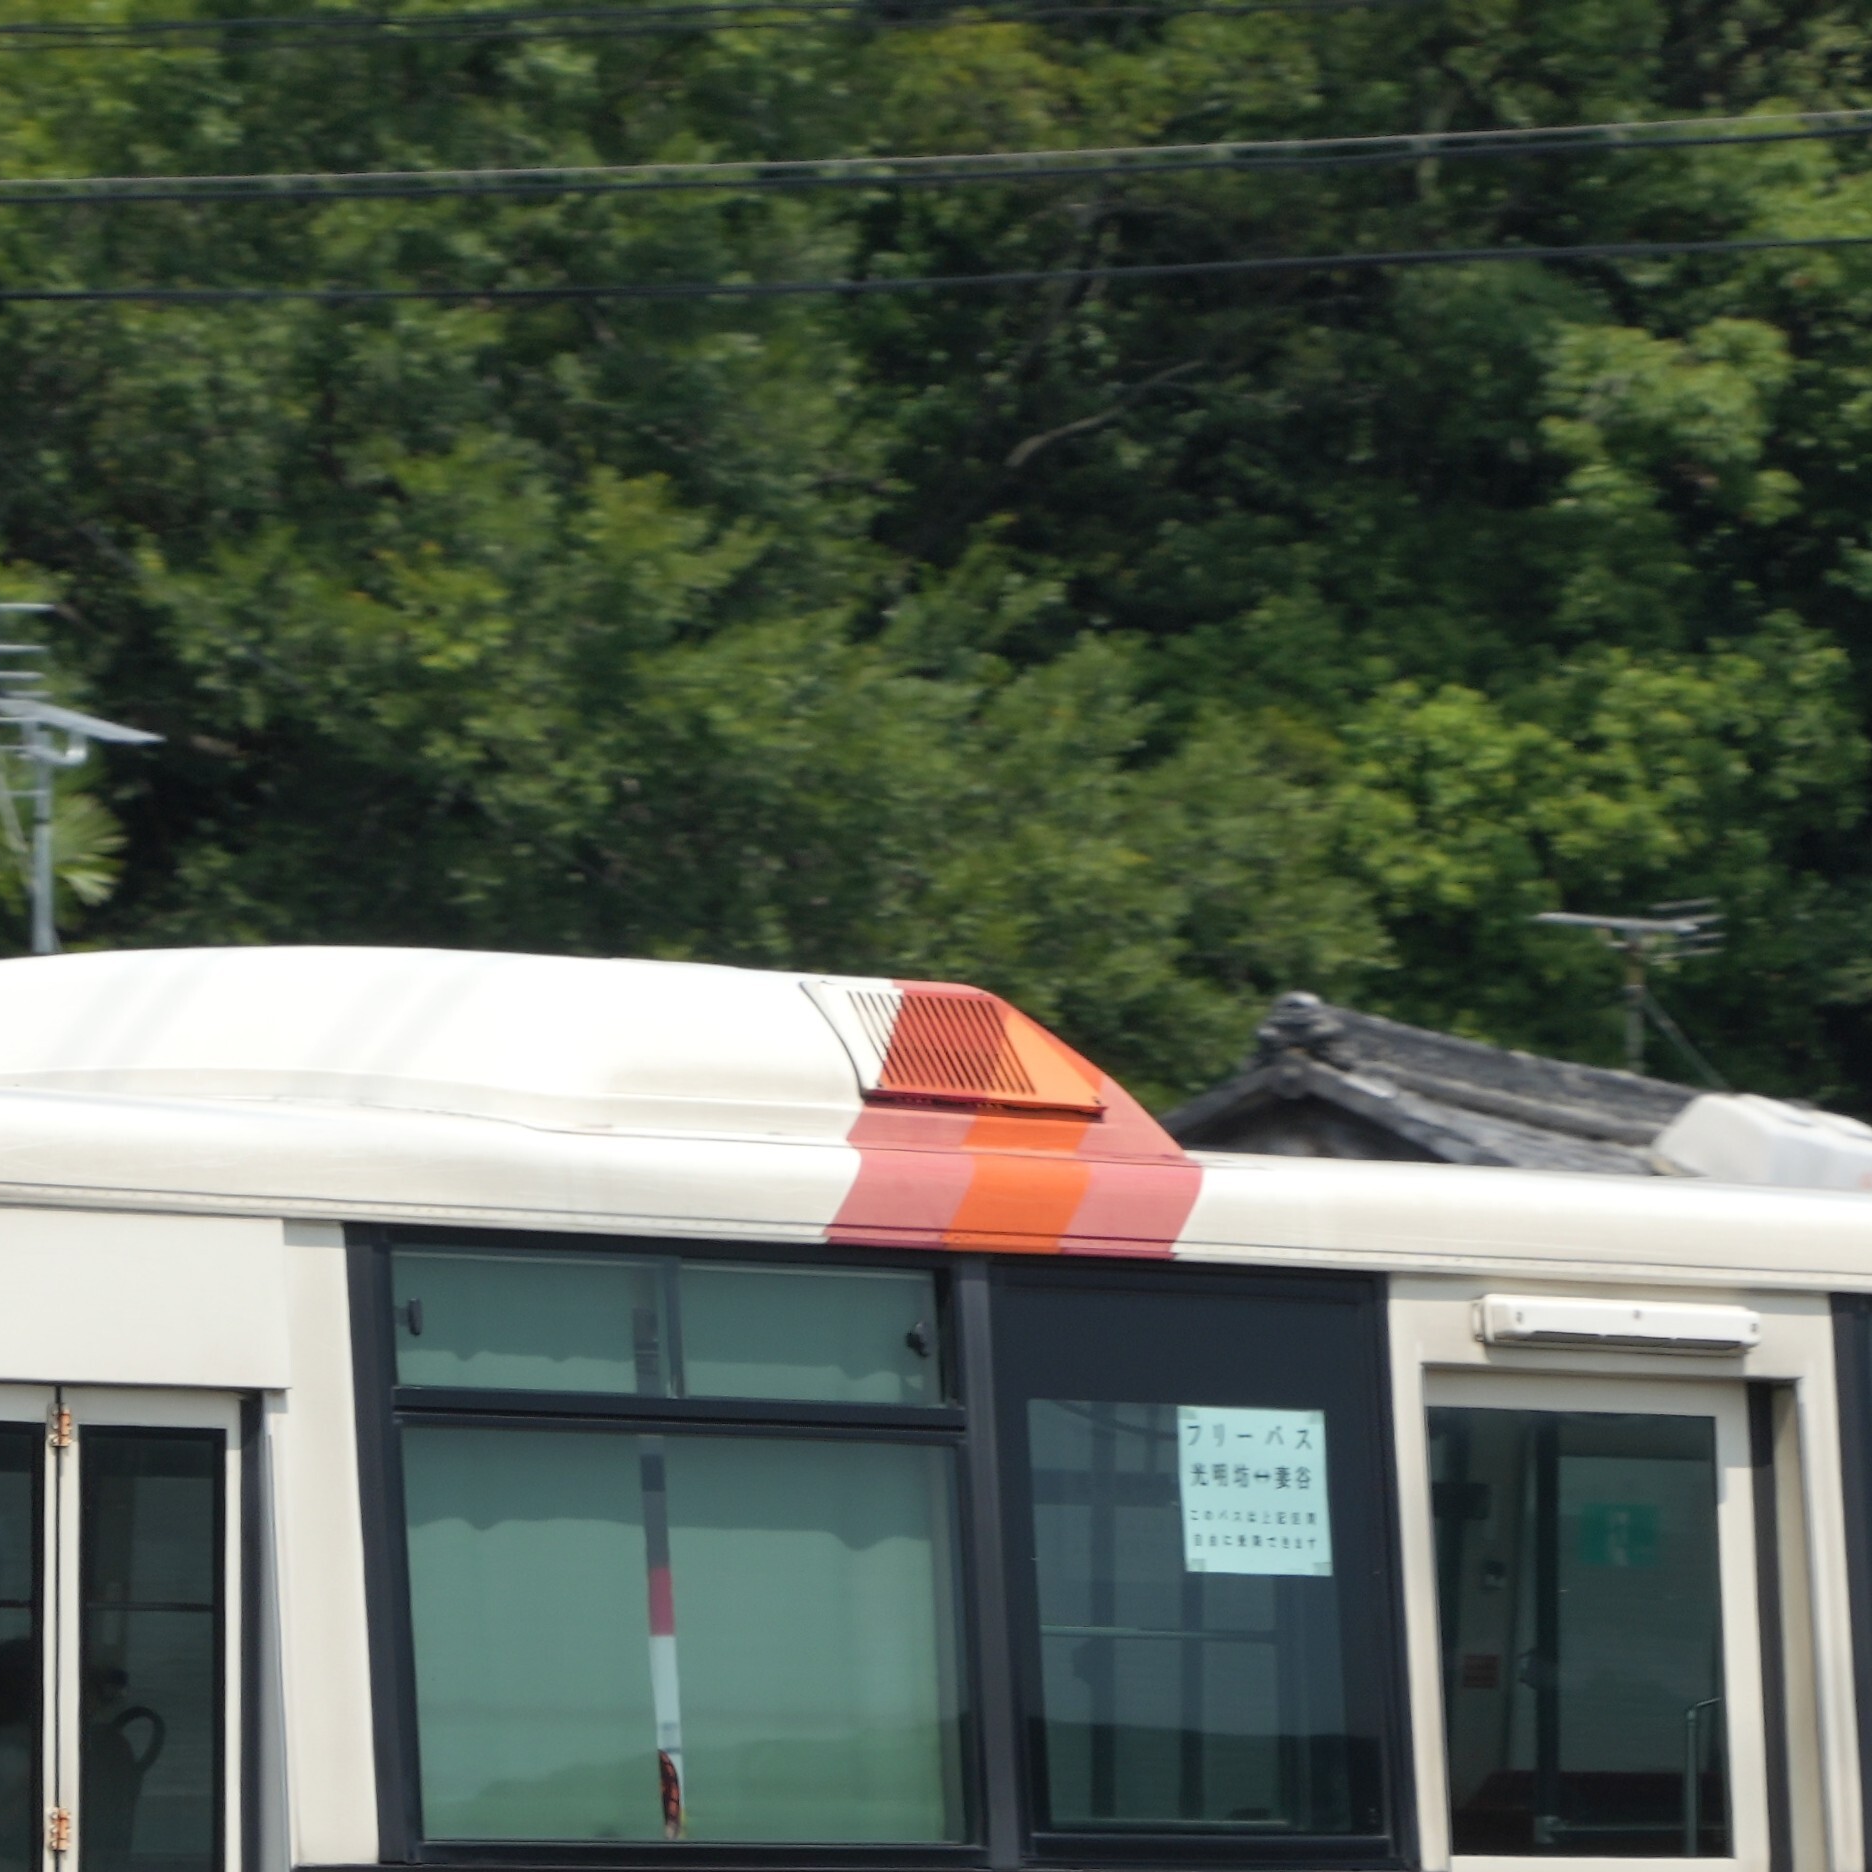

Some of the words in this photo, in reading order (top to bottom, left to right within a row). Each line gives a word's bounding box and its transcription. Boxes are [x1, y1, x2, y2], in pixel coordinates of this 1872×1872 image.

[1186, 1423, 1313, 1450] フリーバス
